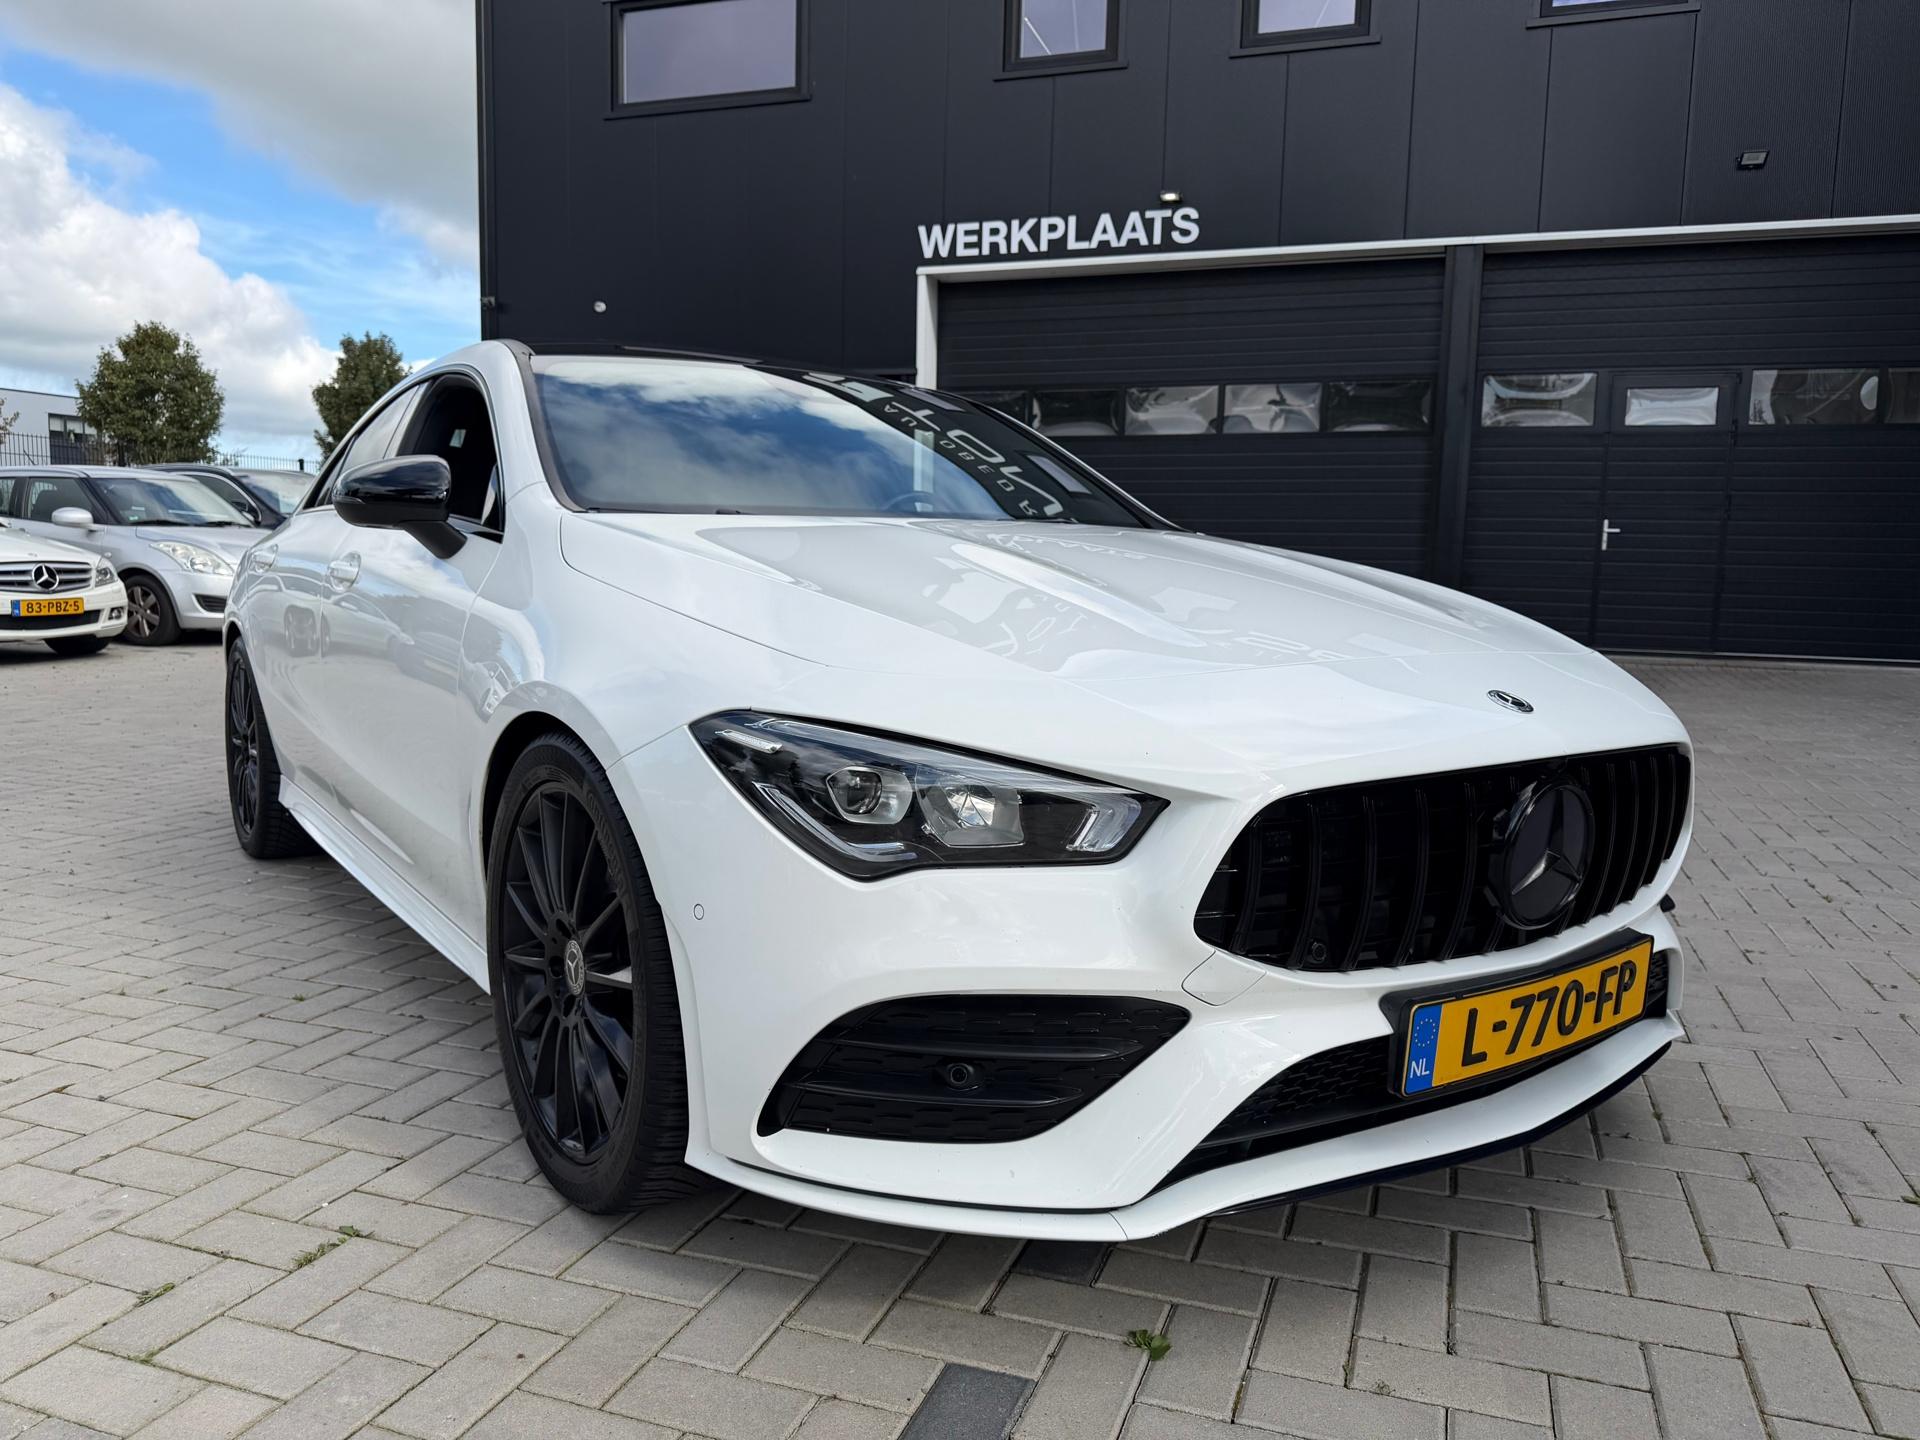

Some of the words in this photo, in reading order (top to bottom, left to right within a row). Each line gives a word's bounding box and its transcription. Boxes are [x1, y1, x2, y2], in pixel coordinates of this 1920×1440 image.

[917, 206, 1200, 259] WERKPLAATS
[26, 601, 80, 614] 83-PBZ-5
[1461, 960, 1637, 1067] L-770-FP
[1410, 1058, 1430, 1078] NL
